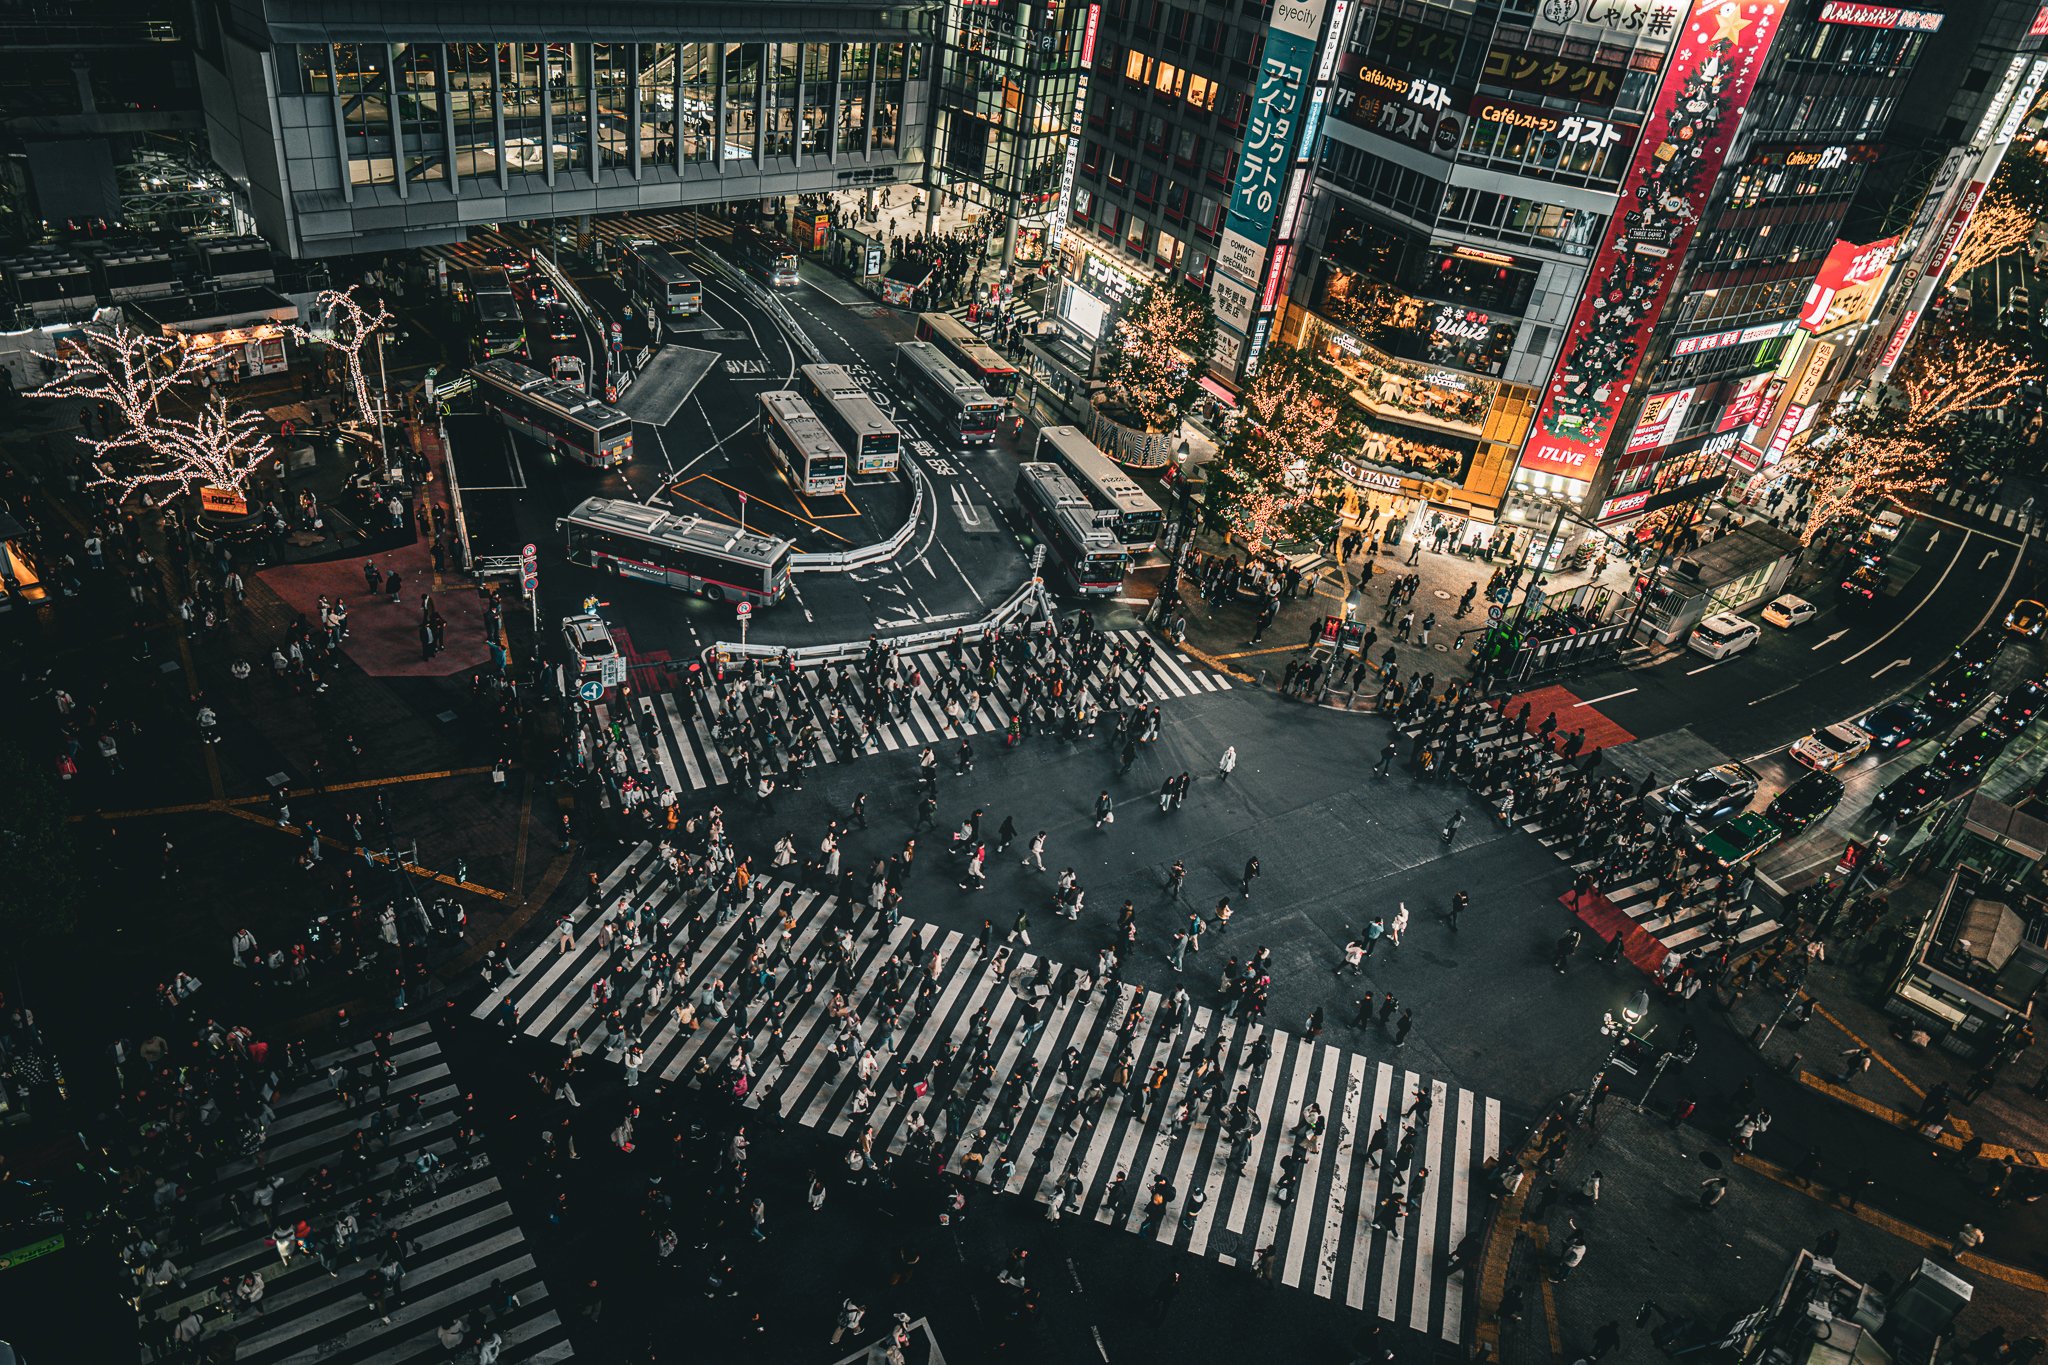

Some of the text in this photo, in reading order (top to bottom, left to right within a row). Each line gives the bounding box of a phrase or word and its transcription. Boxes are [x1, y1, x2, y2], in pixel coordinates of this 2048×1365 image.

[1278, 4, 1317, 29] eyecity
[1374, 20, 1458, 63] プライス
[1484, 51, 1616, 96] コンタクト
[2026, 60, 2047, 86] BIC
[1336, 87, 1356, 108] 7F
[1407, 79, 1452, 111] ガスト
[1378, 102, 1429, 140] ガスト
[1993, 86, 2033, 146] CAMERA
[1557, 115, 1621, 148] ガスト
[1230, 240, 1256, 257] CONTACT
[1233, 251, 1248, 264] LENS
[1222, 254, 1256, 278] SPECIALISTS
[1804, 344, 1831, 387] 処方せん
[1537, 445, 1586, 467] 17LIVE
[1700, 431, 1738, 456] LUSH
[211, 495, 236, 505] RIIZE
